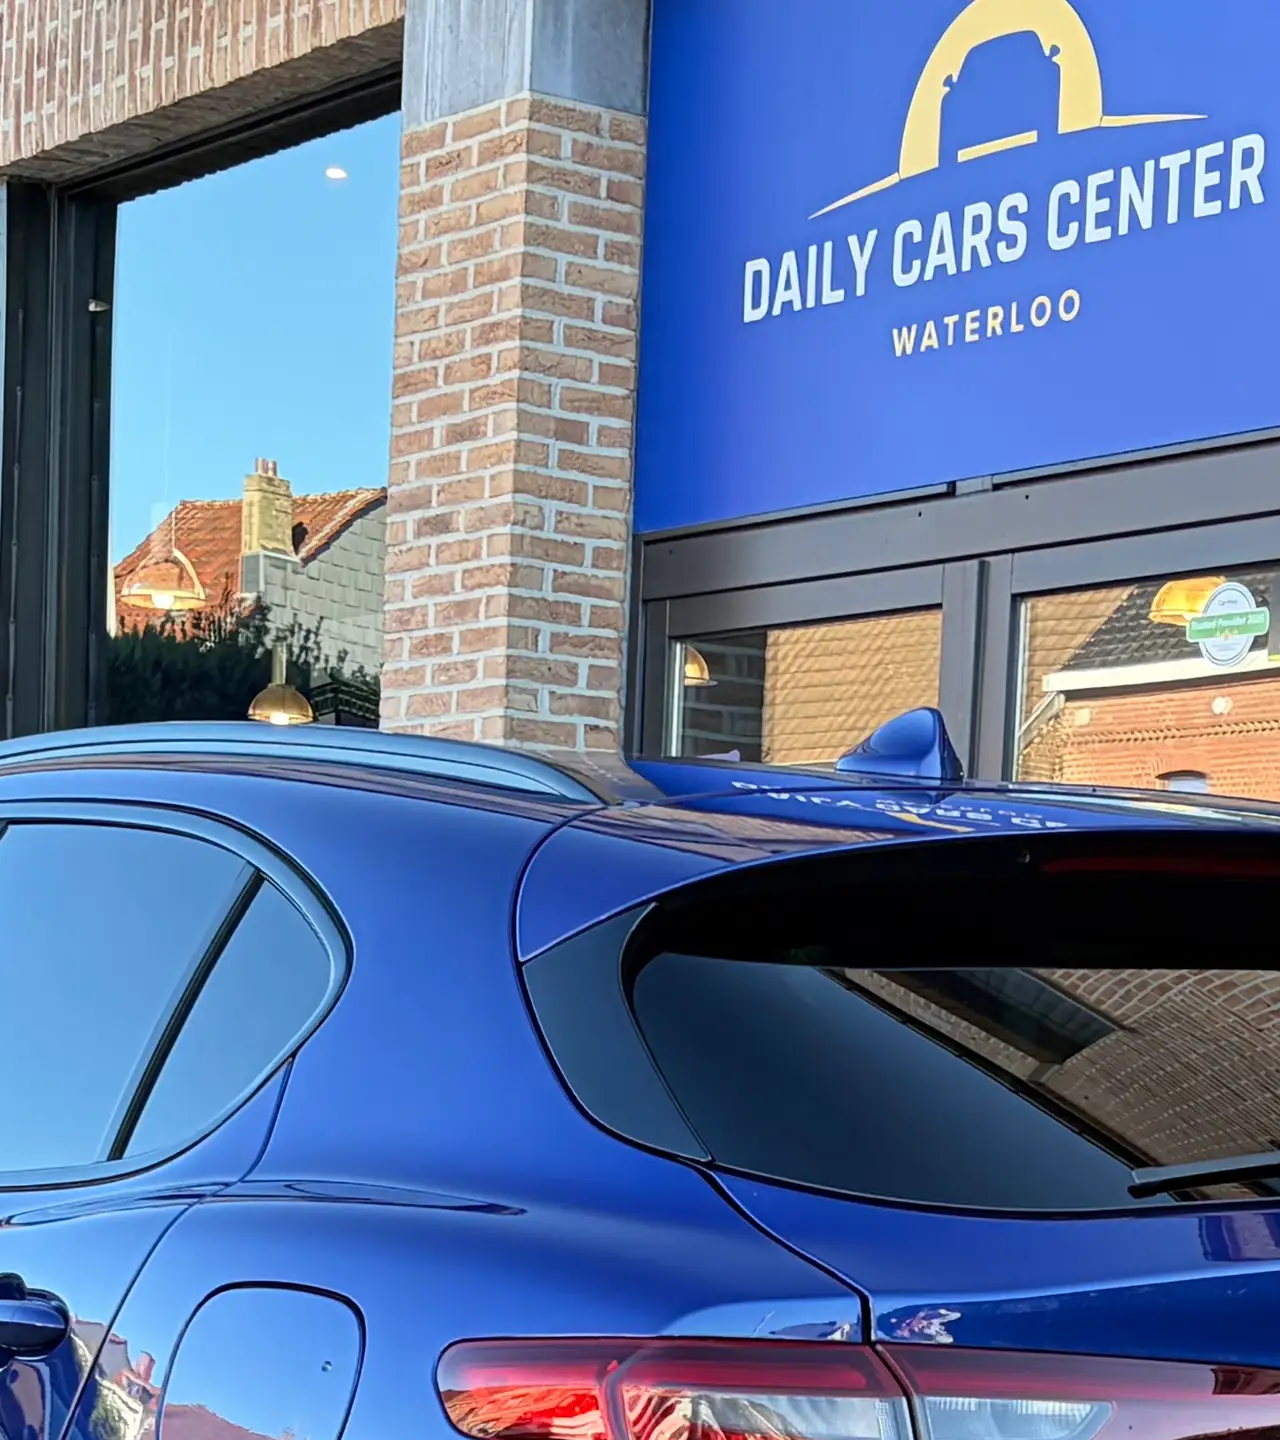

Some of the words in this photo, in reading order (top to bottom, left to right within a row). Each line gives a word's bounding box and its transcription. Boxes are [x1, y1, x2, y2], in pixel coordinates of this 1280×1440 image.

[742, 229, 878, 323] DAILY
[891, 191, 1028, 288] CARS
[1046, 133, 1266, 252] CENTER
[892, 288, 1081, 357] WATERLOO
